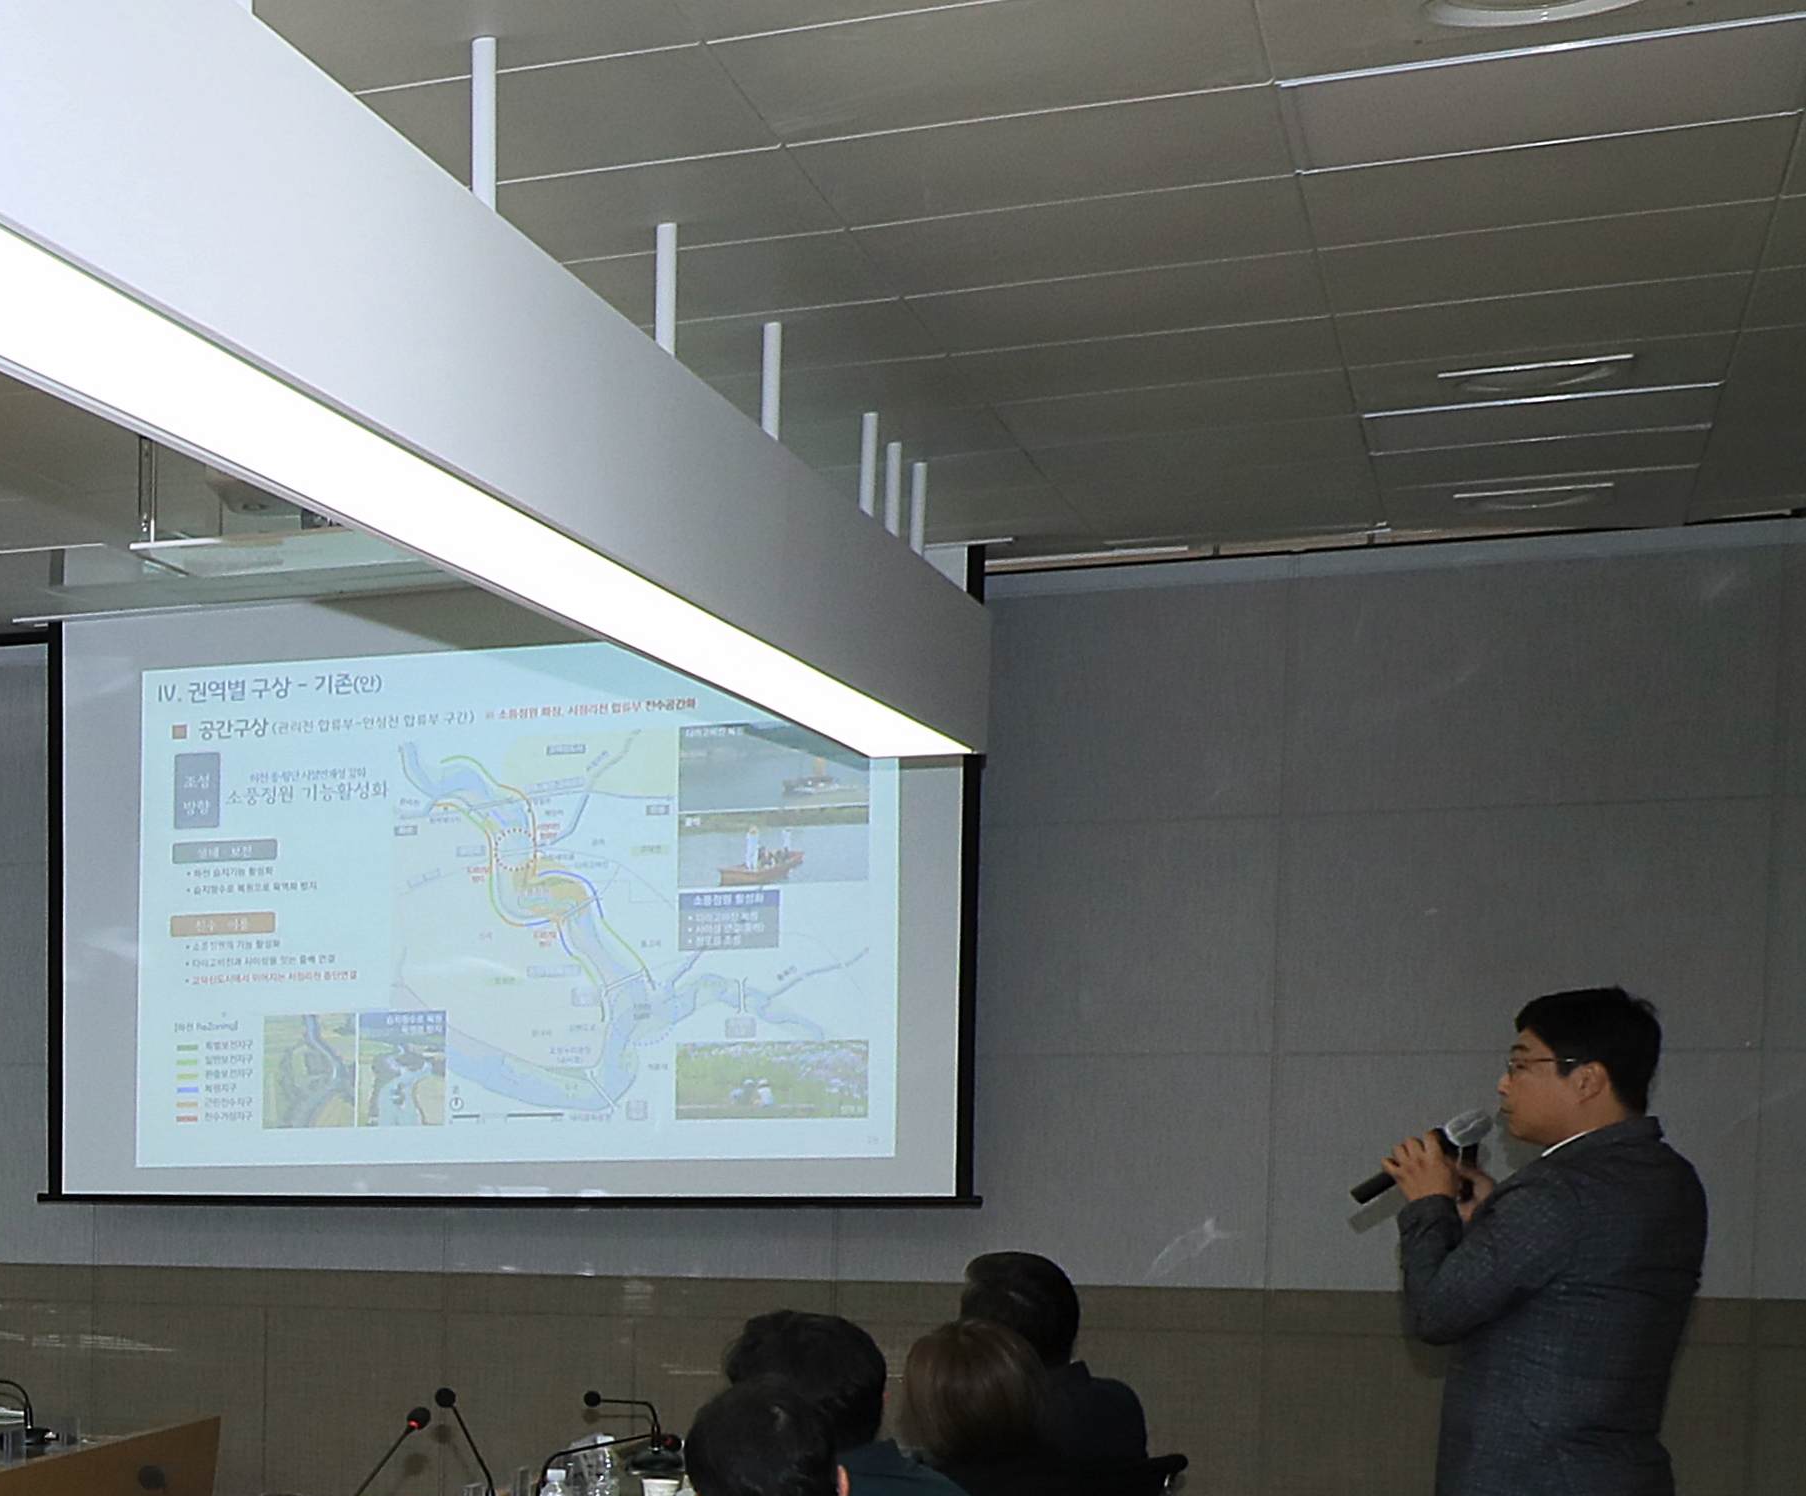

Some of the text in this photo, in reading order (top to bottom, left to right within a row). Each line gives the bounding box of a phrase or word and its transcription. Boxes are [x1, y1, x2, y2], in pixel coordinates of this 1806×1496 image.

[188, 679, 246, 704] 권역별
[251, 677, 292, 700] 구상
[315, 674, 382, 695] 기존(안)
[198, 718, 269, 741] 공간구상
[225, 780, 387, 806] 소풍정원 기능활성화
